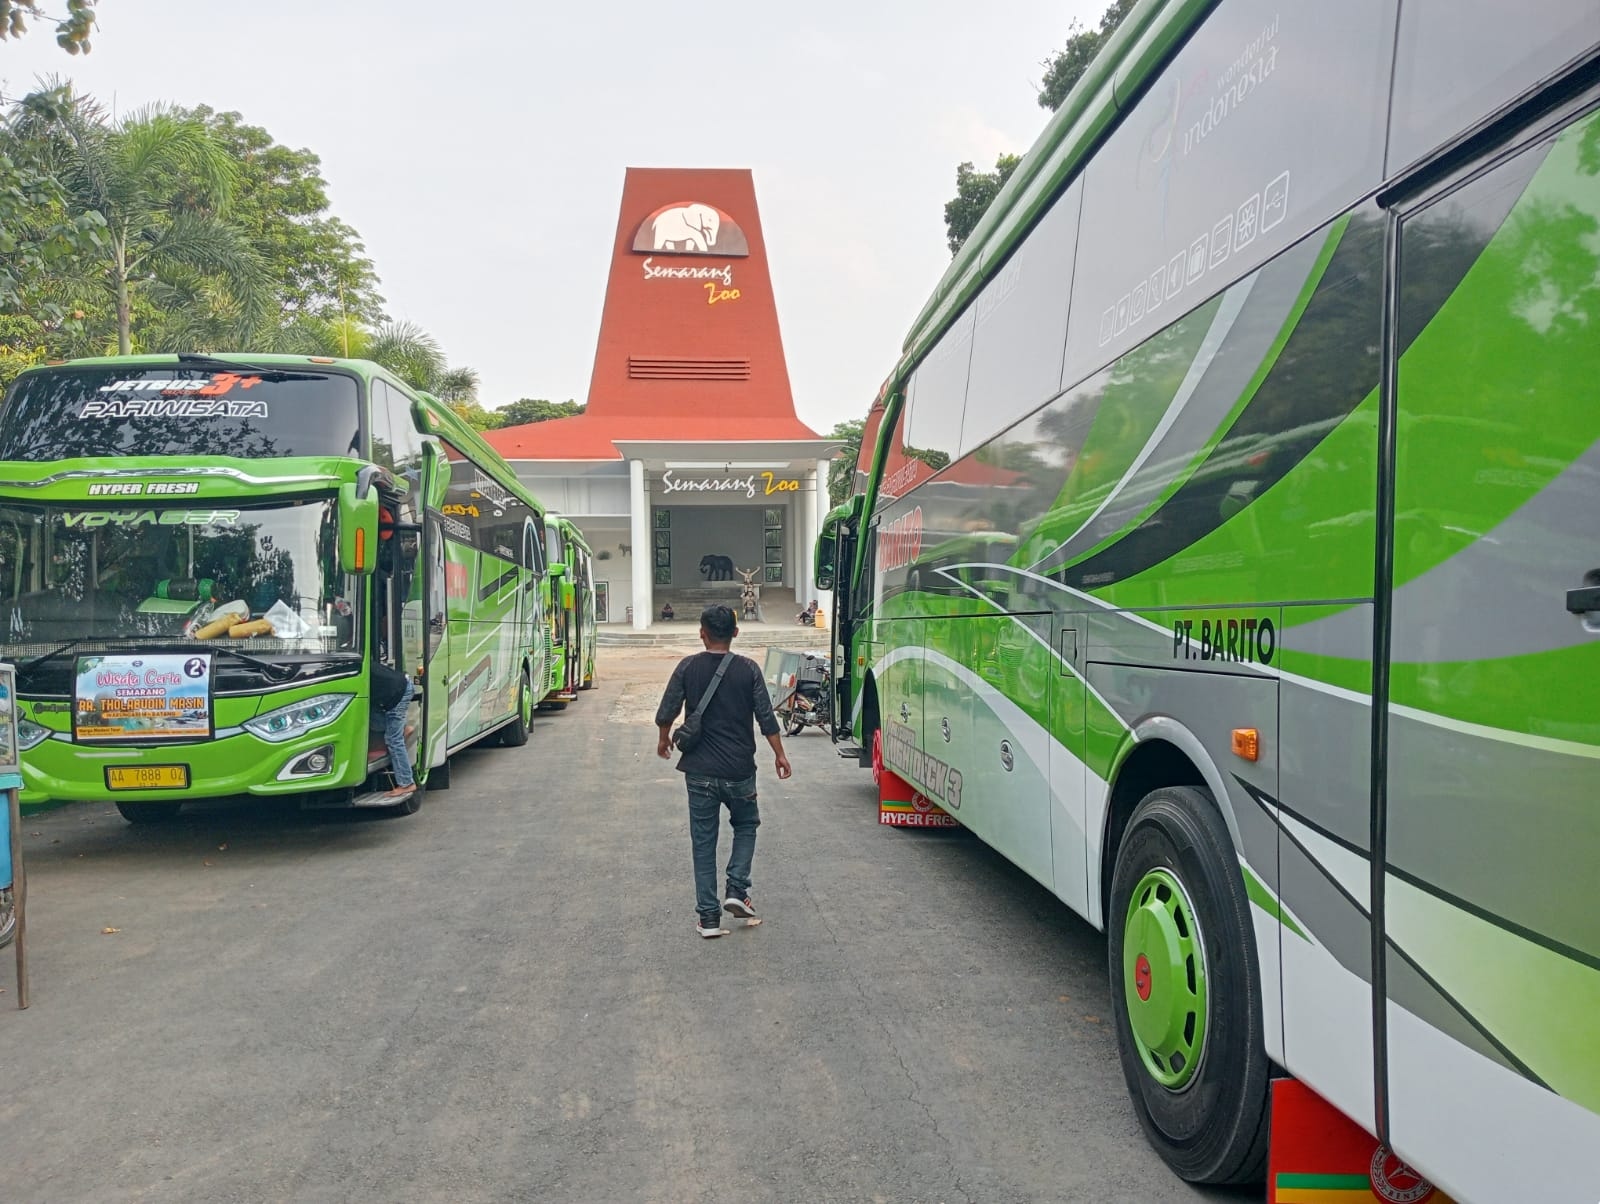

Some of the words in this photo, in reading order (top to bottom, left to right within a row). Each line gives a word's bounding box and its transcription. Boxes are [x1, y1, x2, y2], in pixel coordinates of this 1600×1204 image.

[642, 256, 732, 286] Semarang
[703, 282, 741, 305] Zoo
[101, 380, 210, 392] JETBUS
[79, 401, 268, 419] PARIWISATA
[88, 484, 143, 495] HYPER
[145, 482, 200, 494] FRESH
[662, 470, 756, 498] Semarang
[761, 471, 800, 495] Zoo
[63, 510, 241, 527] VOYAGER
[1173, 620, 1197, 660] PT.
[1200, 617, 1276, 665] BARITO
[189, 659, 201, 676] 2
[97, 671, 139, 687] Wisata
[116, 688, 166, 697] SEMARANG
[111, 770, 125, 782] AA
[947, 767, 963, 810] 3
[881, 812, 923, 825] HYPER
[925, 814, 959, 826] FRES
